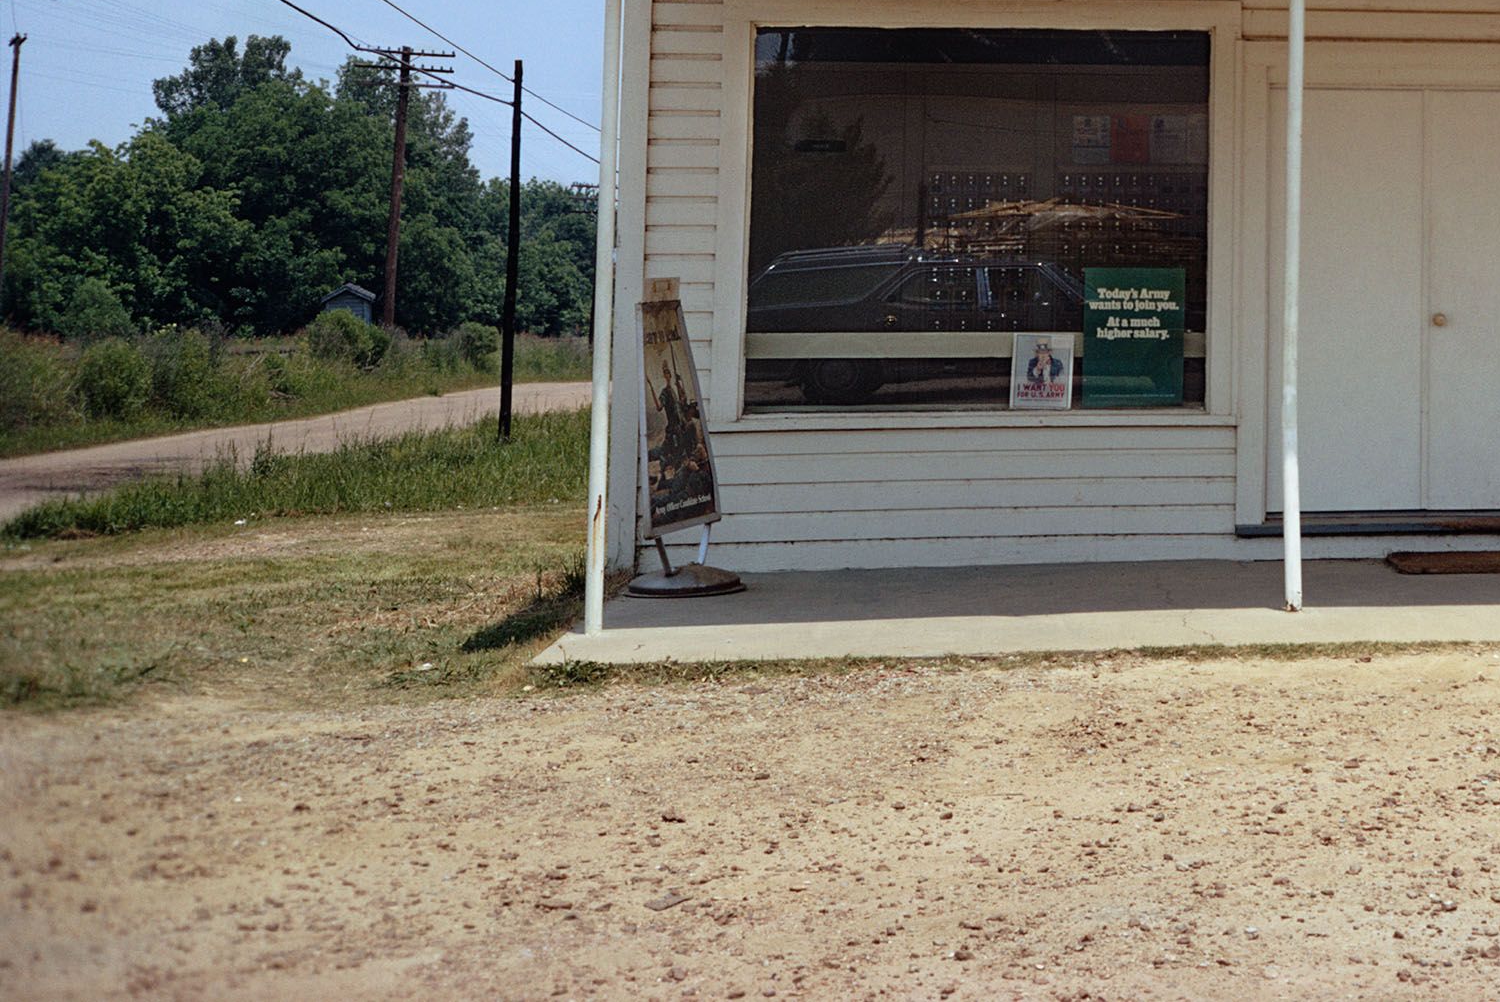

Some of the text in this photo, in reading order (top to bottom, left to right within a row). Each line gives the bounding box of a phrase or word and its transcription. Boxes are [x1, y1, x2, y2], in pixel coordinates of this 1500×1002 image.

[1098, 288, 1170, 300] Today's Army
[1088, 299, 1180, 312] wants to join you.
[1106, 316, 1161, 327] At a much
[1095, 327, 1170, 340] higher salary.
[1023, 383, 1047, 391] WANT
[1049, 383, 1065, 391] YOU
